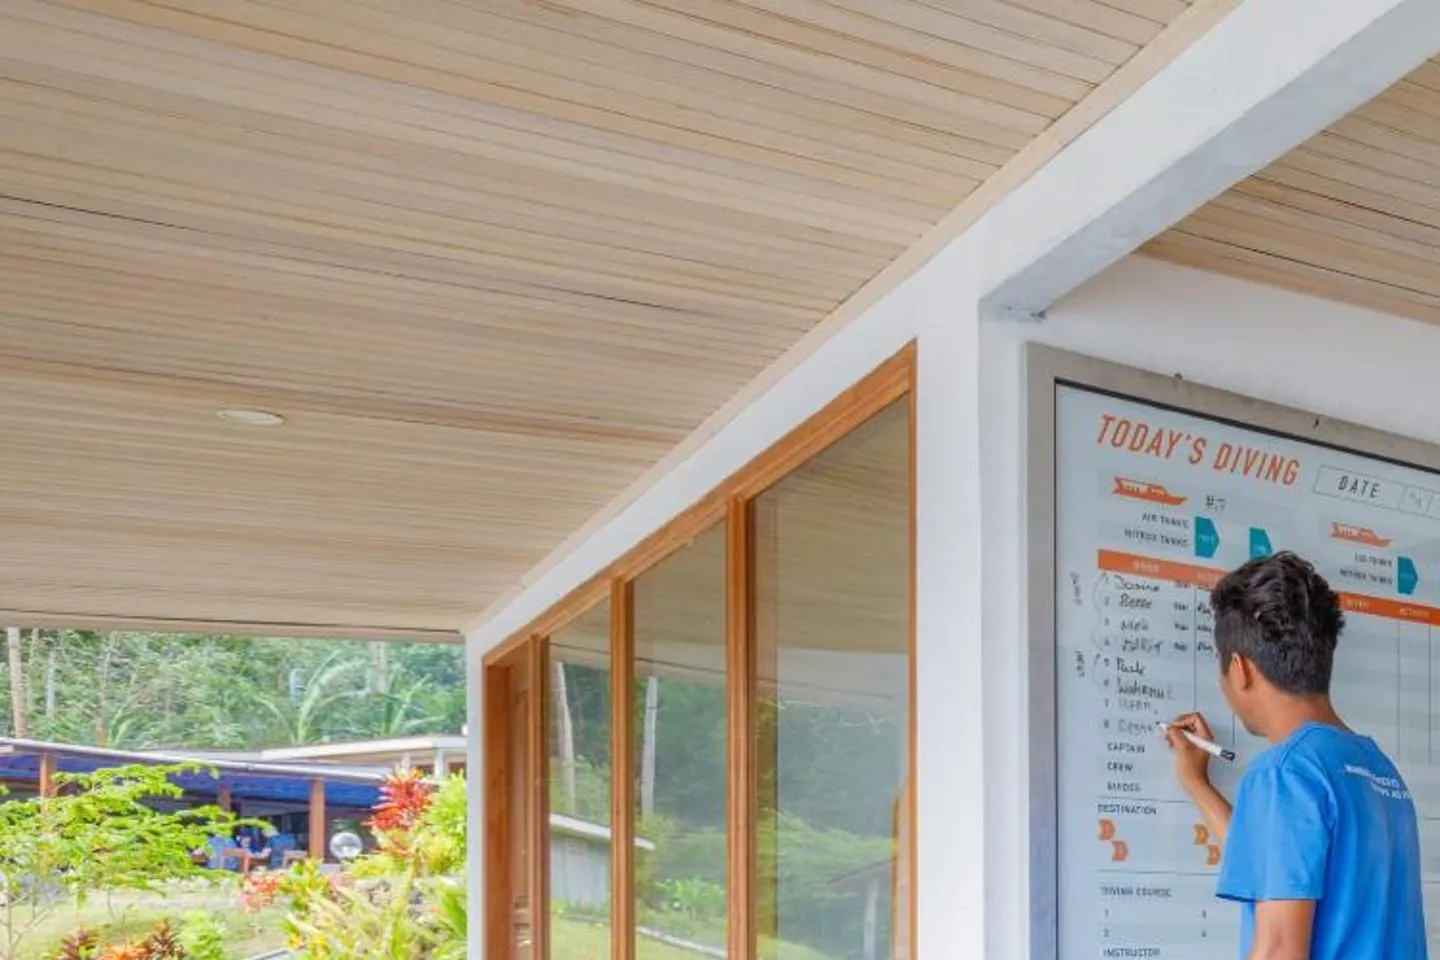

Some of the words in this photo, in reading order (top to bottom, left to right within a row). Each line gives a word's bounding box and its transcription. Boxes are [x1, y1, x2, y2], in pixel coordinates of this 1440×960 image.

[1097, 414, 1207, 466] TODAY'S
[1213, 443, 1301, 487] DIVING
[1337, 475, 1382, 499] DATE
[1160, 515, 1188, 530] TANKS
[1160, 535, 1188, 548] TANKS
[1107, 742, 1145, 753] CAPTAIN
[1107, 762, 1133, 772] CREW
[1107, 782, 1141, 792] GUIDES
[1098, 804, 1157, 815] DESTINATION
[1136, 887, 1172, 898] COURSE
[1103, 947, 1160, 958] INSTRUCTOR
